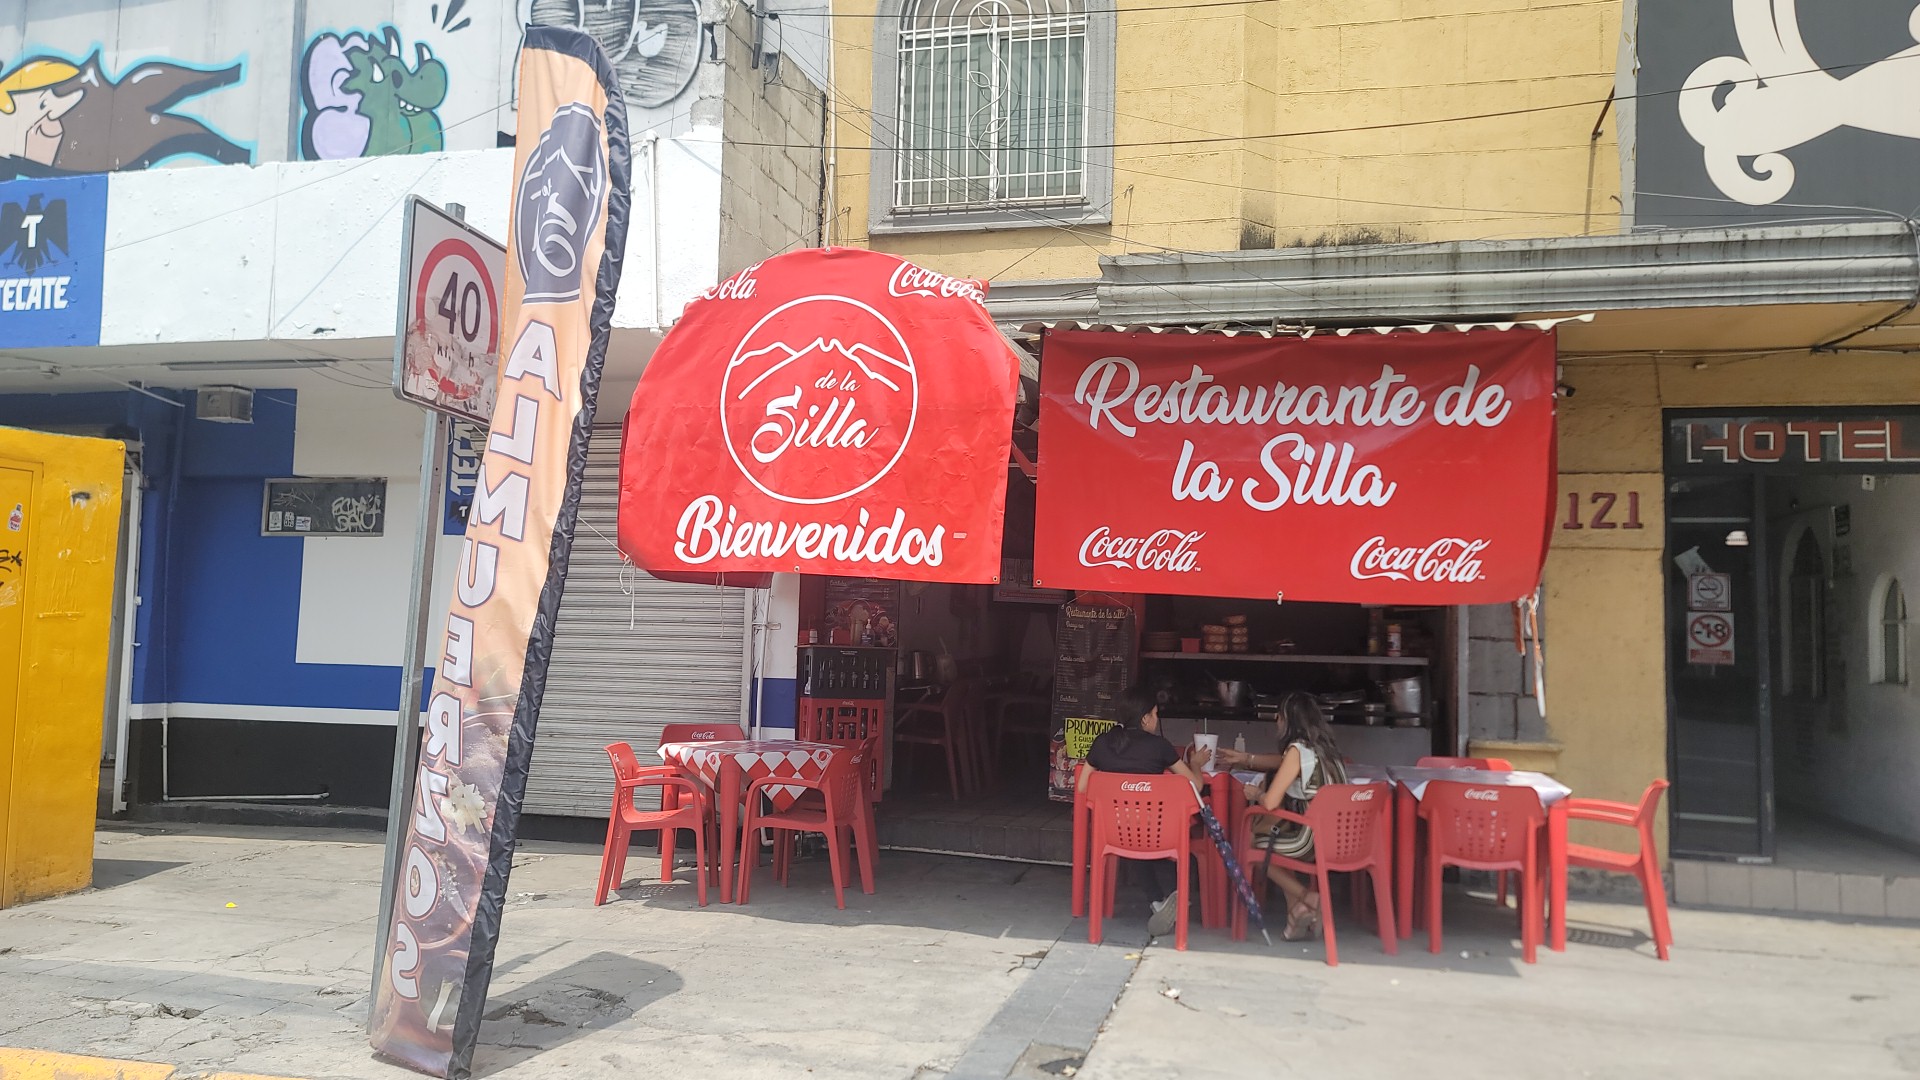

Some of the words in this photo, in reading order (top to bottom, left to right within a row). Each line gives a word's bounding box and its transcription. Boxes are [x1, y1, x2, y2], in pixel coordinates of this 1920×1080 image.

[21, 215, 44, 248] T
[438, 271, 482, 343] 40
[815, 370, 836, 390] de
[839, 370, 861, 391] la
[1075, 356, 1426, 438] Restaurante
[1433, 364, 1512, 427] de
[751, 385, 880, 464] Silla
[1685, 420, 1920, 464] HOTEL
[1171, 440, 1234, 502] la
[1241, 432, 1398, 512] Silla
[674, 494, 946, 567] Bienvenidos
[1562, 491, 1644, 530] 121
[1078, 526, 1206, 572] Coca-Cola
[1350, 535, 1492, 583] Coca-Cola
[1066, 719, 1116, 735] PROMOCIO
[1121, 781, 1152, 792] Coca-Cola
